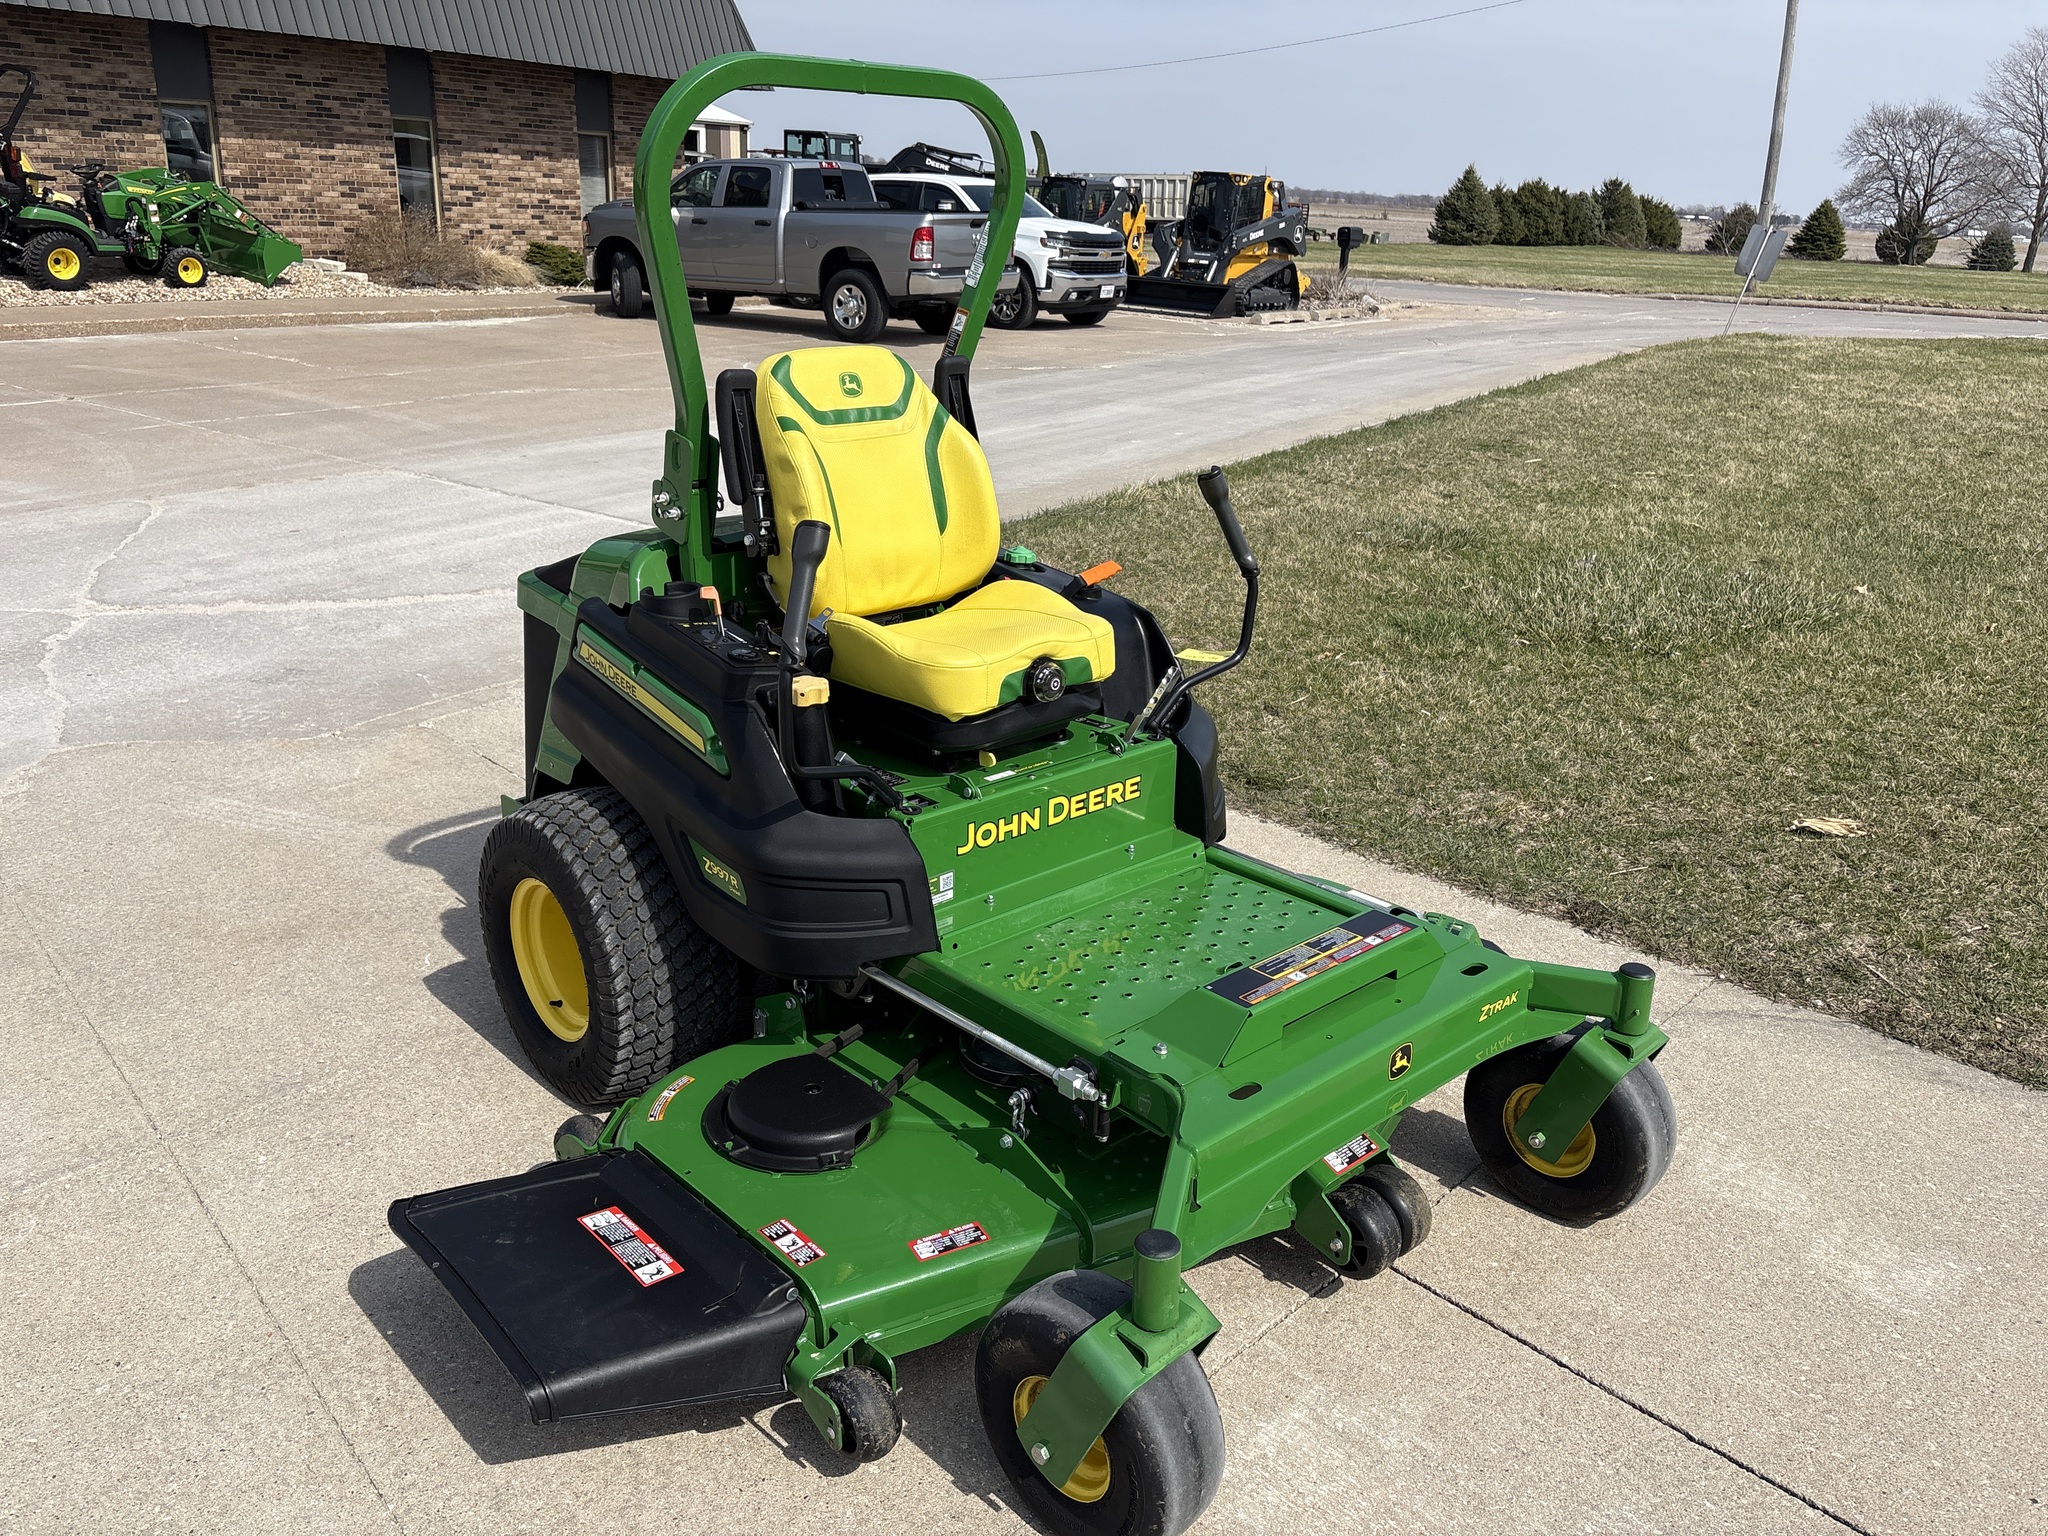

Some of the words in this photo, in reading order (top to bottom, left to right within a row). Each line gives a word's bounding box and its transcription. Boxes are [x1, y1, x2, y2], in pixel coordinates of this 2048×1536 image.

[925, 157, 950, 171] DEERE
[584, 648, 608, 676] JOHN
[608, 667, 638, 699] DEERE
[956, 806, 1042, 856] JOHN
[1048, 774, 1142, 827] DEERE
[1478, 989, 1520, 1023] ZTRAK
